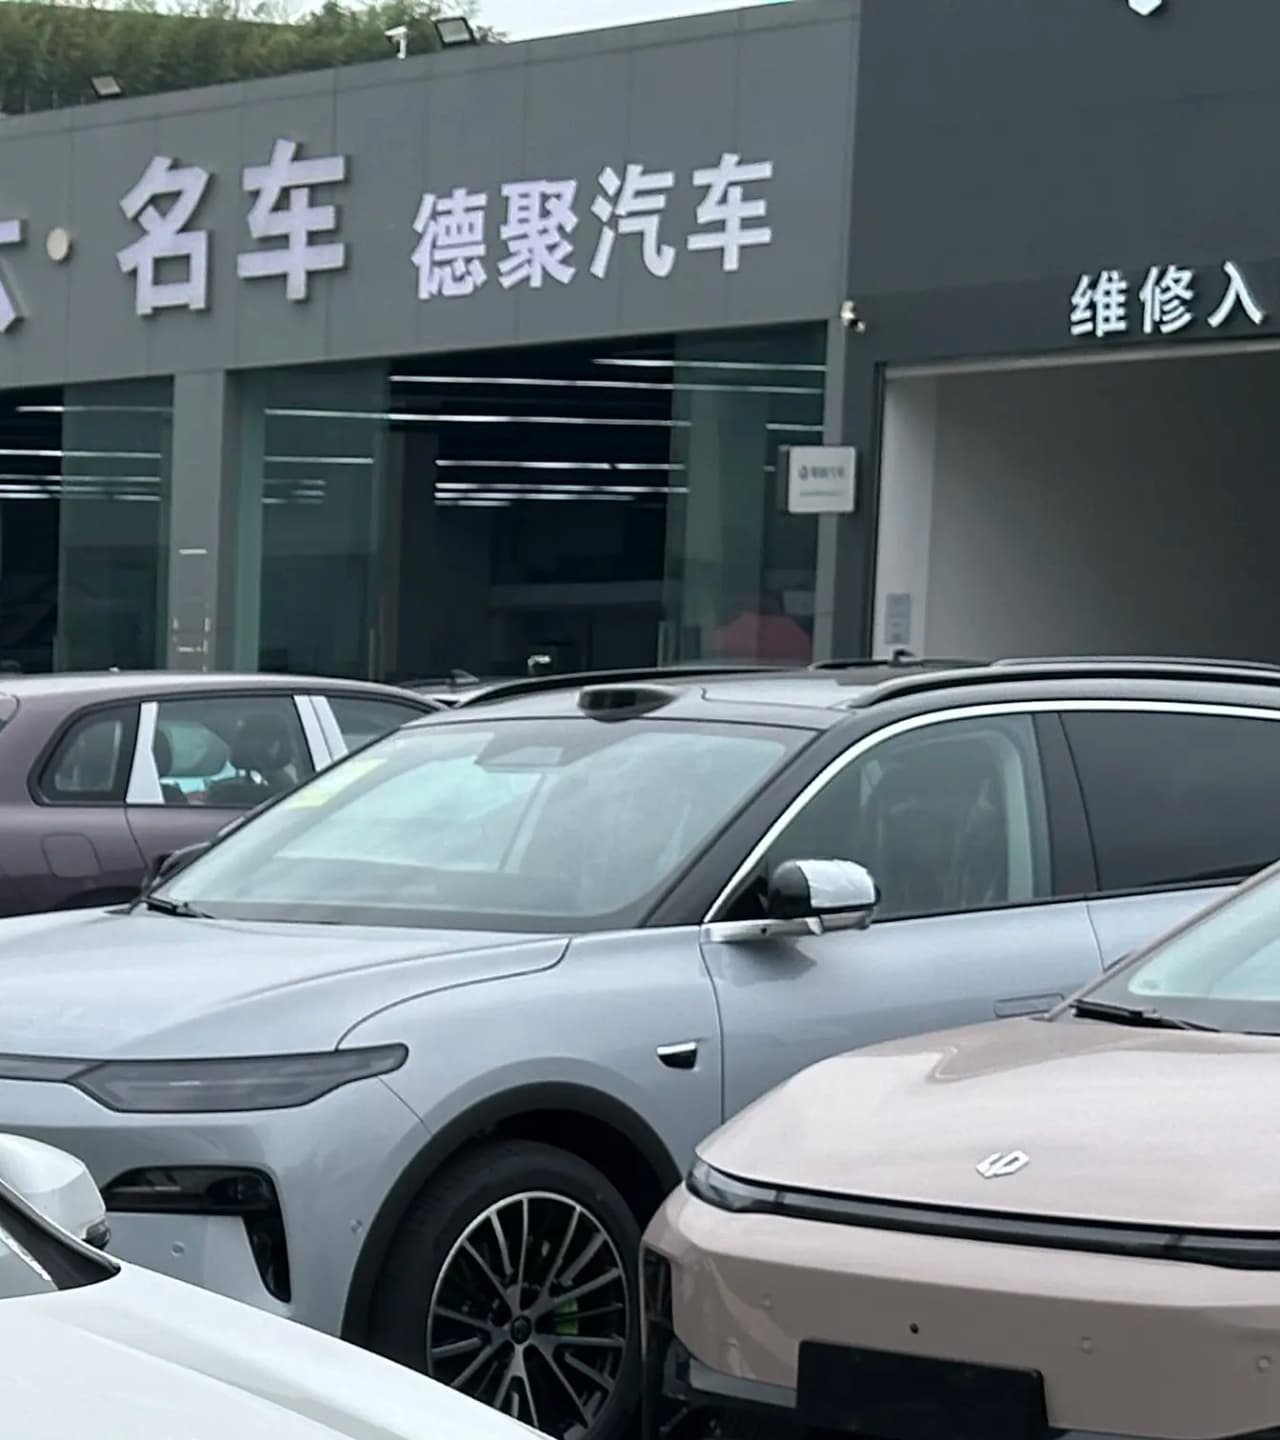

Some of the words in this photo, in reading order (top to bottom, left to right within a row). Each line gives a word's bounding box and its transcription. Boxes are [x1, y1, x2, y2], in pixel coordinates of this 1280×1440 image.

[411, 153, 773, 299] 德聚汽车
[1070, 261, 1263, 337] 维修入
